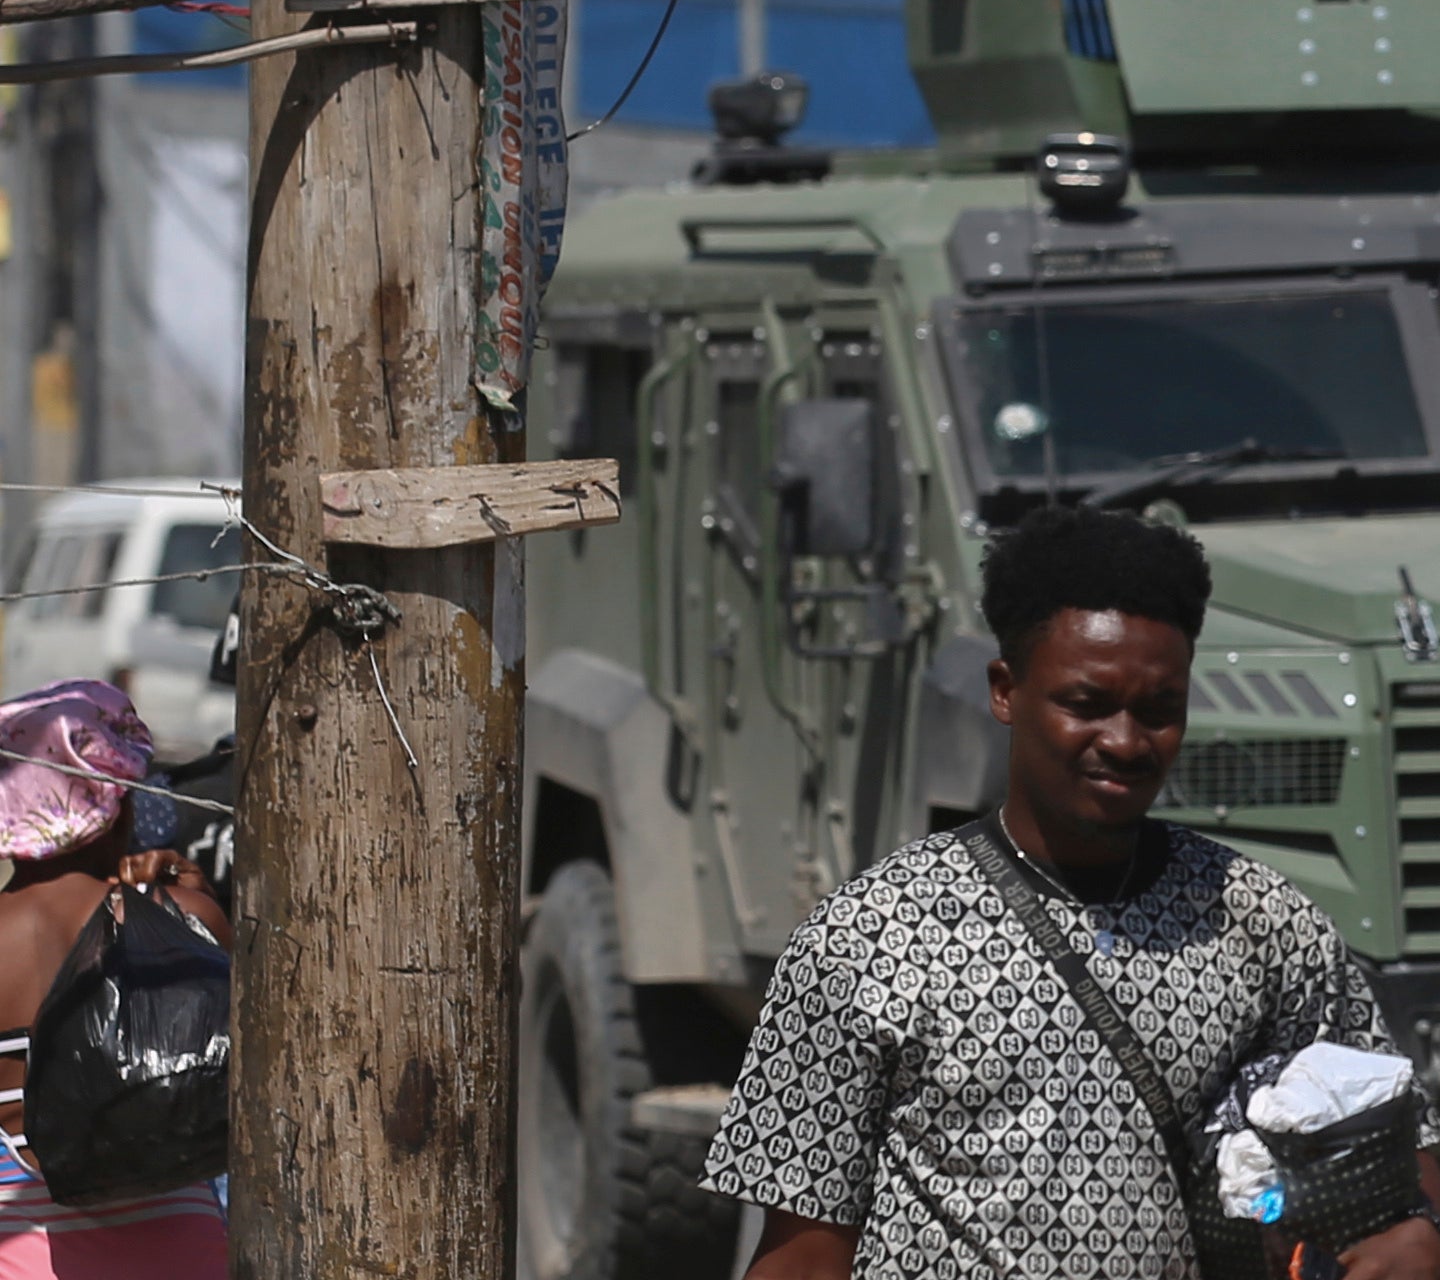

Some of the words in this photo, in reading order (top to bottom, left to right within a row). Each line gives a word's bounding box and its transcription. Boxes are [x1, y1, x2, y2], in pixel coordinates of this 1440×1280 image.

[535, 4, 565, 165] OLLEGE
[965, 831, 1011, 883] YOUNG
[1003, 879, 1072, 961] FOREVER
[1075, 977, 1124, 1043] YOUNG
[1117, 1041, 1174, 1127] FOREVER
